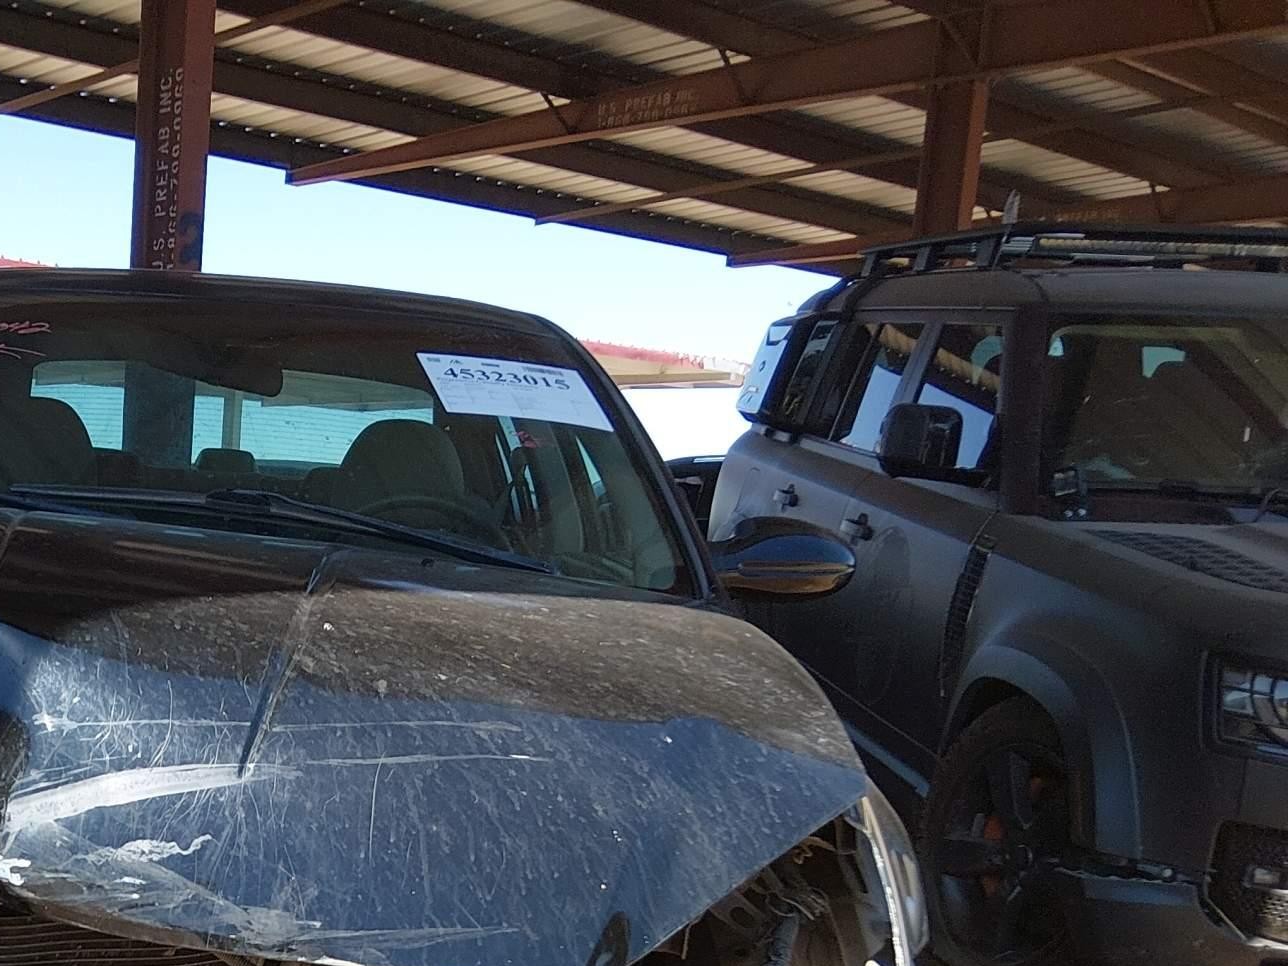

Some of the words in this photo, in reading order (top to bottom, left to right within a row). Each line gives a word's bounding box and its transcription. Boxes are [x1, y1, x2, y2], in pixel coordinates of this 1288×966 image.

[159, 68, 173, 114] INC.
[155, 127, 170, 217] PREFAB
[443, 367, 571, 391] 45323015
